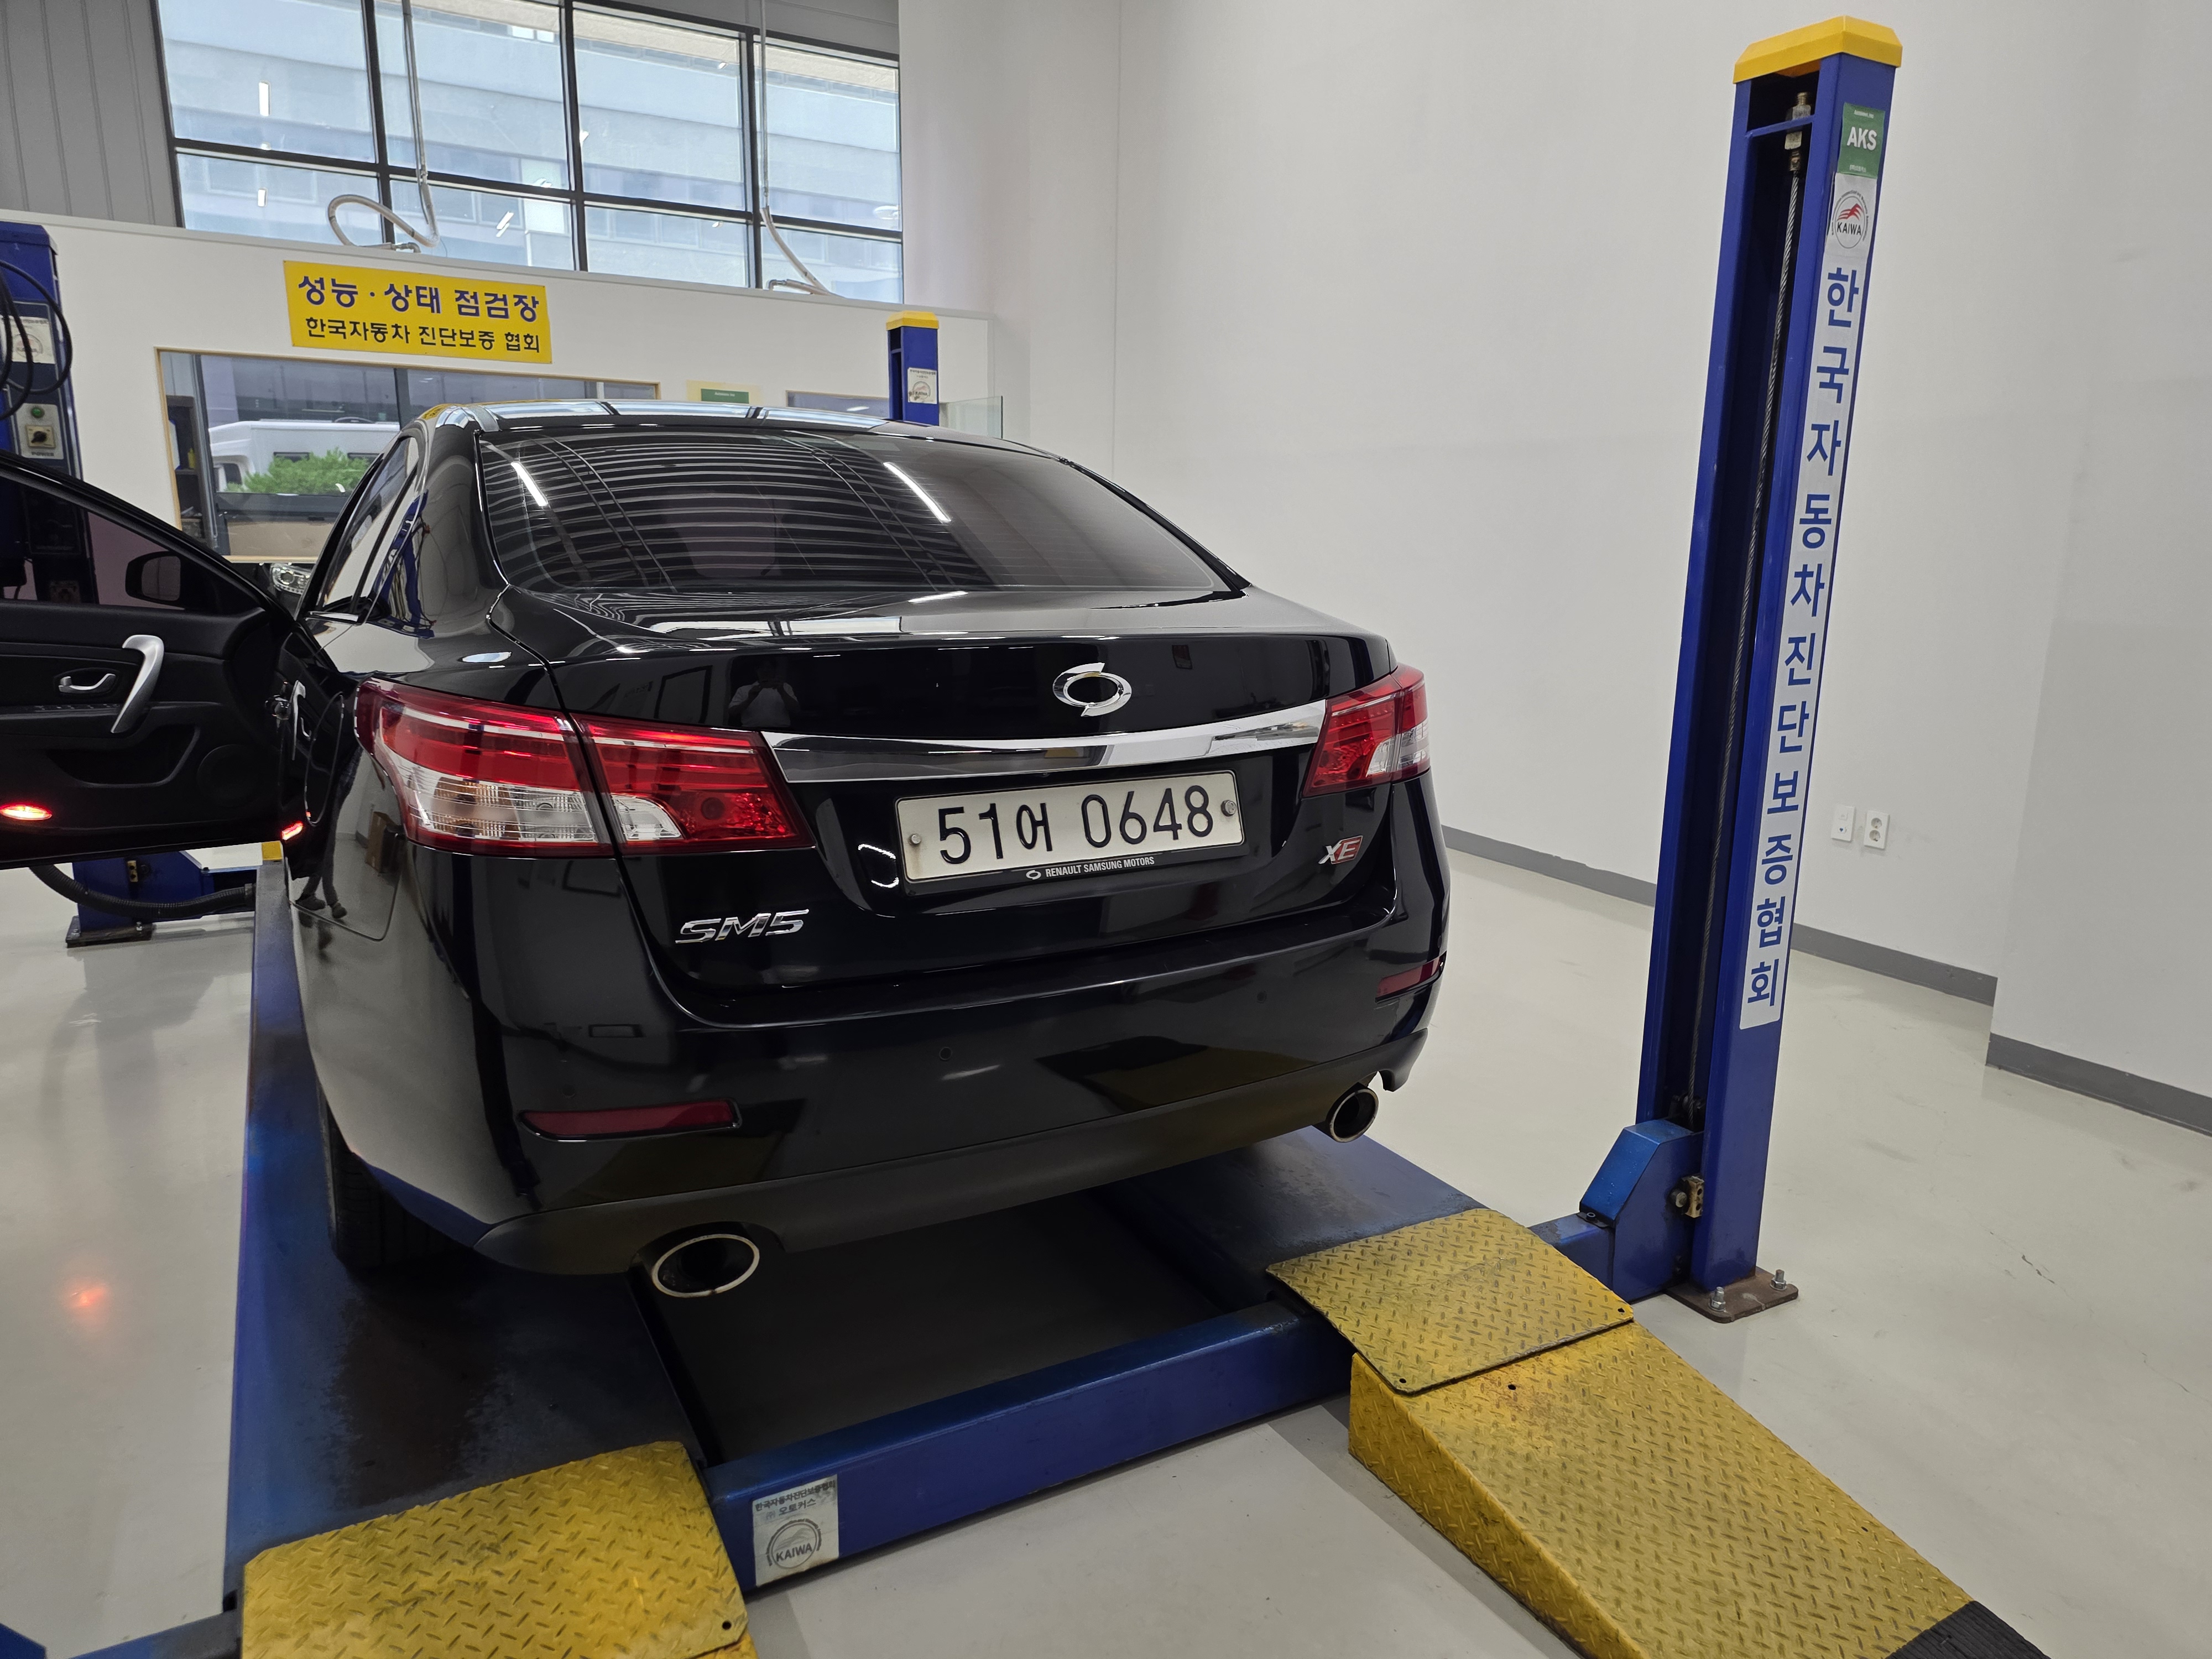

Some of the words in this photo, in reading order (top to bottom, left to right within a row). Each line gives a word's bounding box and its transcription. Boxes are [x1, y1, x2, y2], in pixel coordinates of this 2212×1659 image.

[1846, 126, 1877, 151] AKS
[1837, 222, 1862, 236] KAIWA
[455, 289, 540, 322] 점검장
[306, 317, 410, 344] 한국자동차
[418, 326, 495, 350] 진단보증
[504, 332, 540, 353] 협회
[940, 802, 1053, 864] 51어
[1081, 785, 1213, 848] 0648
[1318, 836, 1362, 864] XE
[1045, 864, 1082, 878] RENAULT
[1083, 860, 1123, 873] SAMSUNG
[1123, 857, 1155, 868] MOTORS
[675, 909, 809, 944] SM5
[779, 1498, 816, 1516] 오토커스
[776, 1542, 813, 1562] KAIWA
